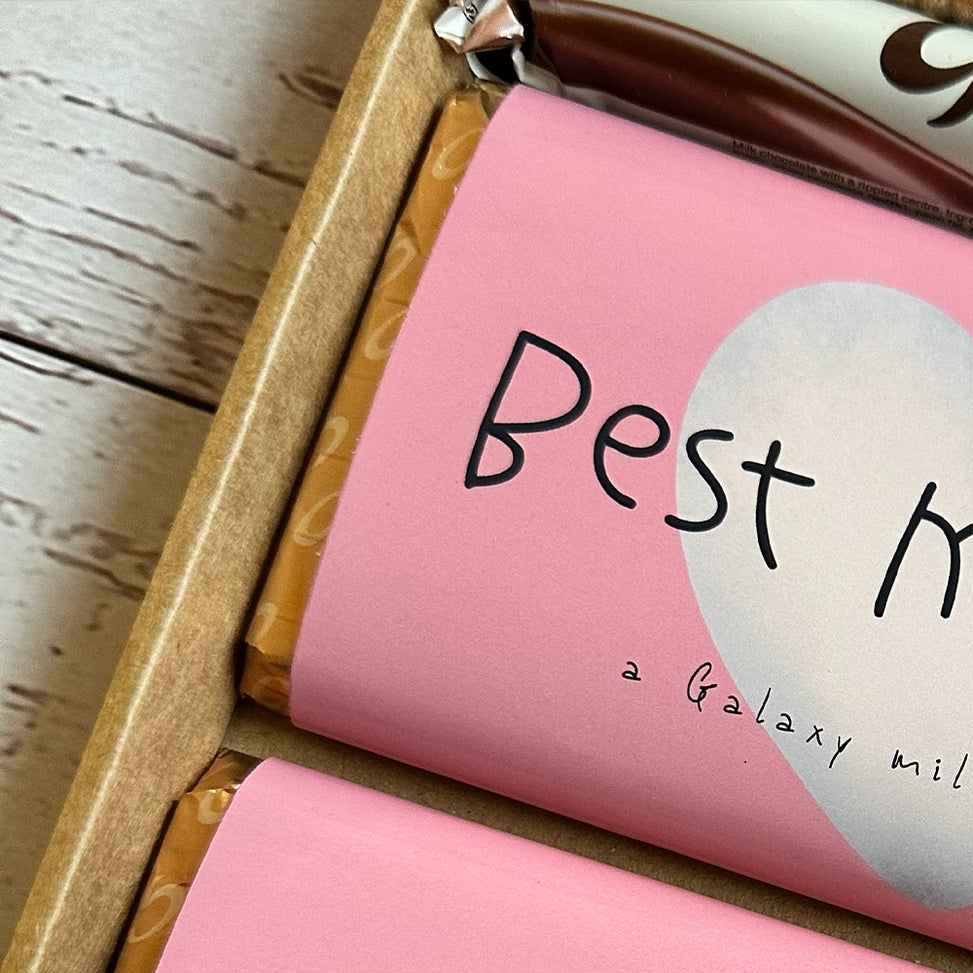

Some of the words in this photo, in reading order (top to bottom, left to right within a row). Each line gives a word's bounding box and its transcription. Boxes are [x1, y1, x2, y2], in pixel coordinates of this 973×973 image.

[758, 149, 818, 175] chocolate
[819, 168, 845, 183] with
[857, 181, 899, 202] rippled
[464, 331, 815, 569] Best
[622, 662, 641, 681] a
[687, 662, 851, 768] Galaxy
